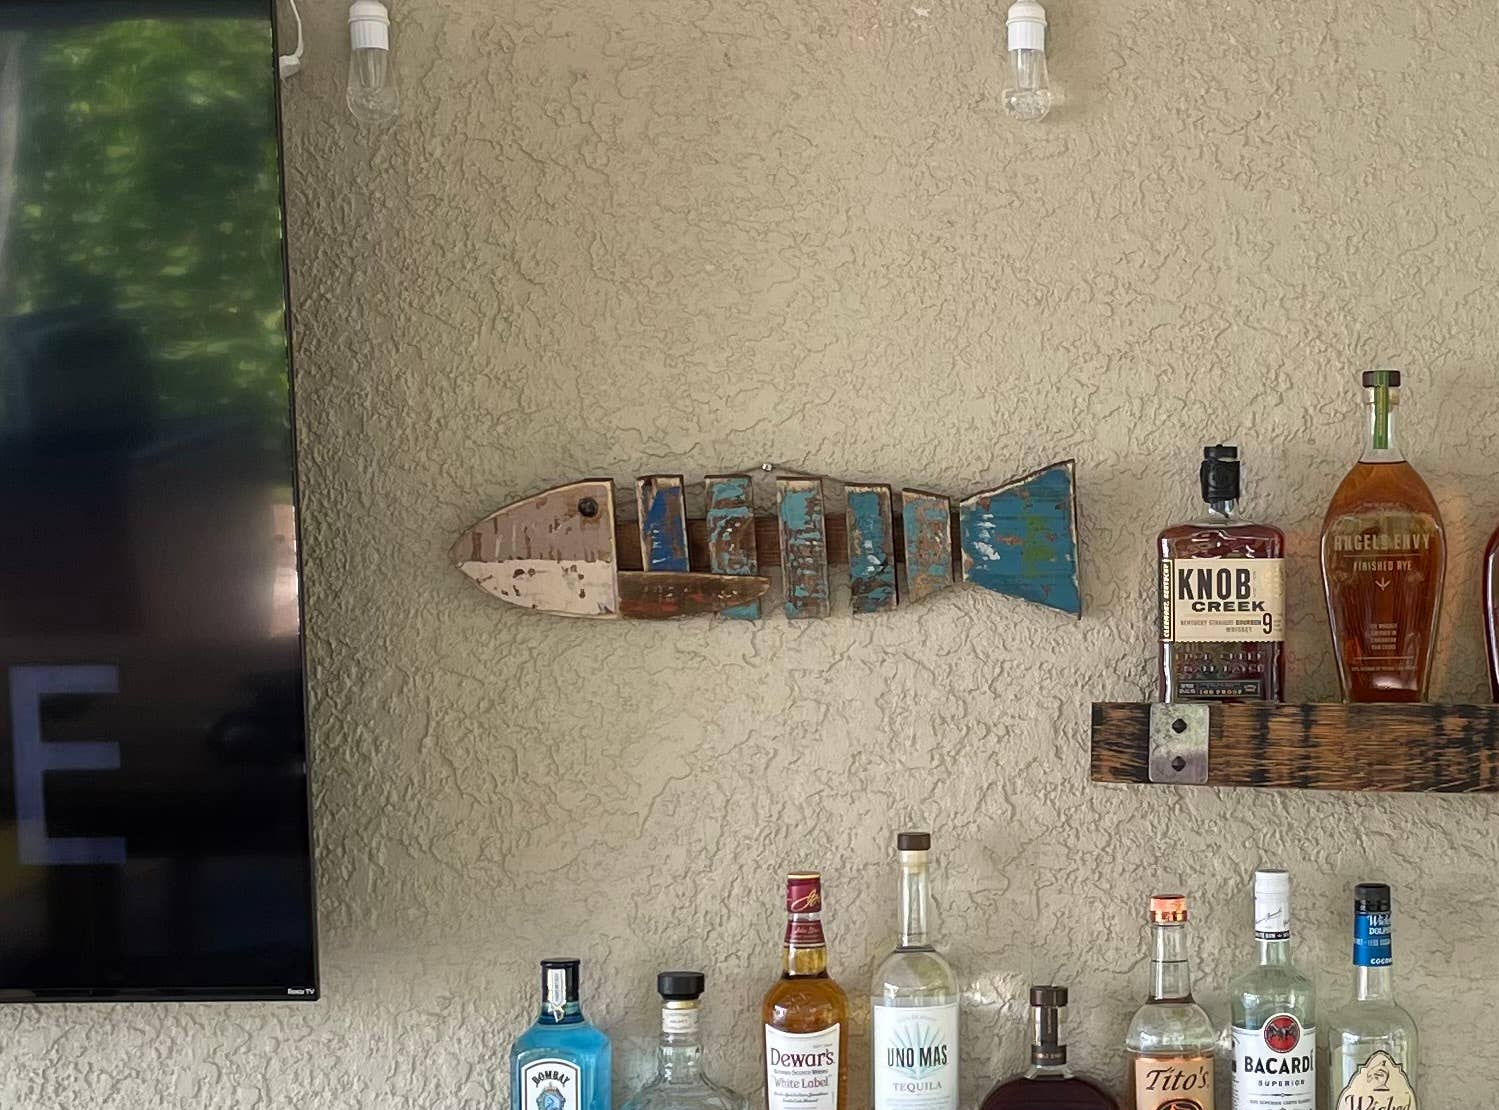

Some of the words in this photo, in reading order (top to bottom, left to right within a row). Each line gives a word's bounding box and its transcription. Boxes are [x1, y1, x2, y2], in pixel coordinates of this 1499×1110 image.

[1394, 533, 1430, 550] ENVY
[1396, 560, 1412, 571] RYE
[1178, 568, 1251, 600] KNOB
[1191, 601, 1265, 612] CREEK
[1262, 612, 1273, 635] 9
[770, 1047, 834, 1068] Dewar's
[887, 1047, 914, 1068] UNO
[919, 1044, 948, 1067] MAS
[531, 1070, 570, 1088] BOMBAY
[892, 1081, 942, 1093] TEQUILA
[1145, 1065, 1210, 1091] Tito's
[1258, 1079, 1305, 1087] SUPERIOR
